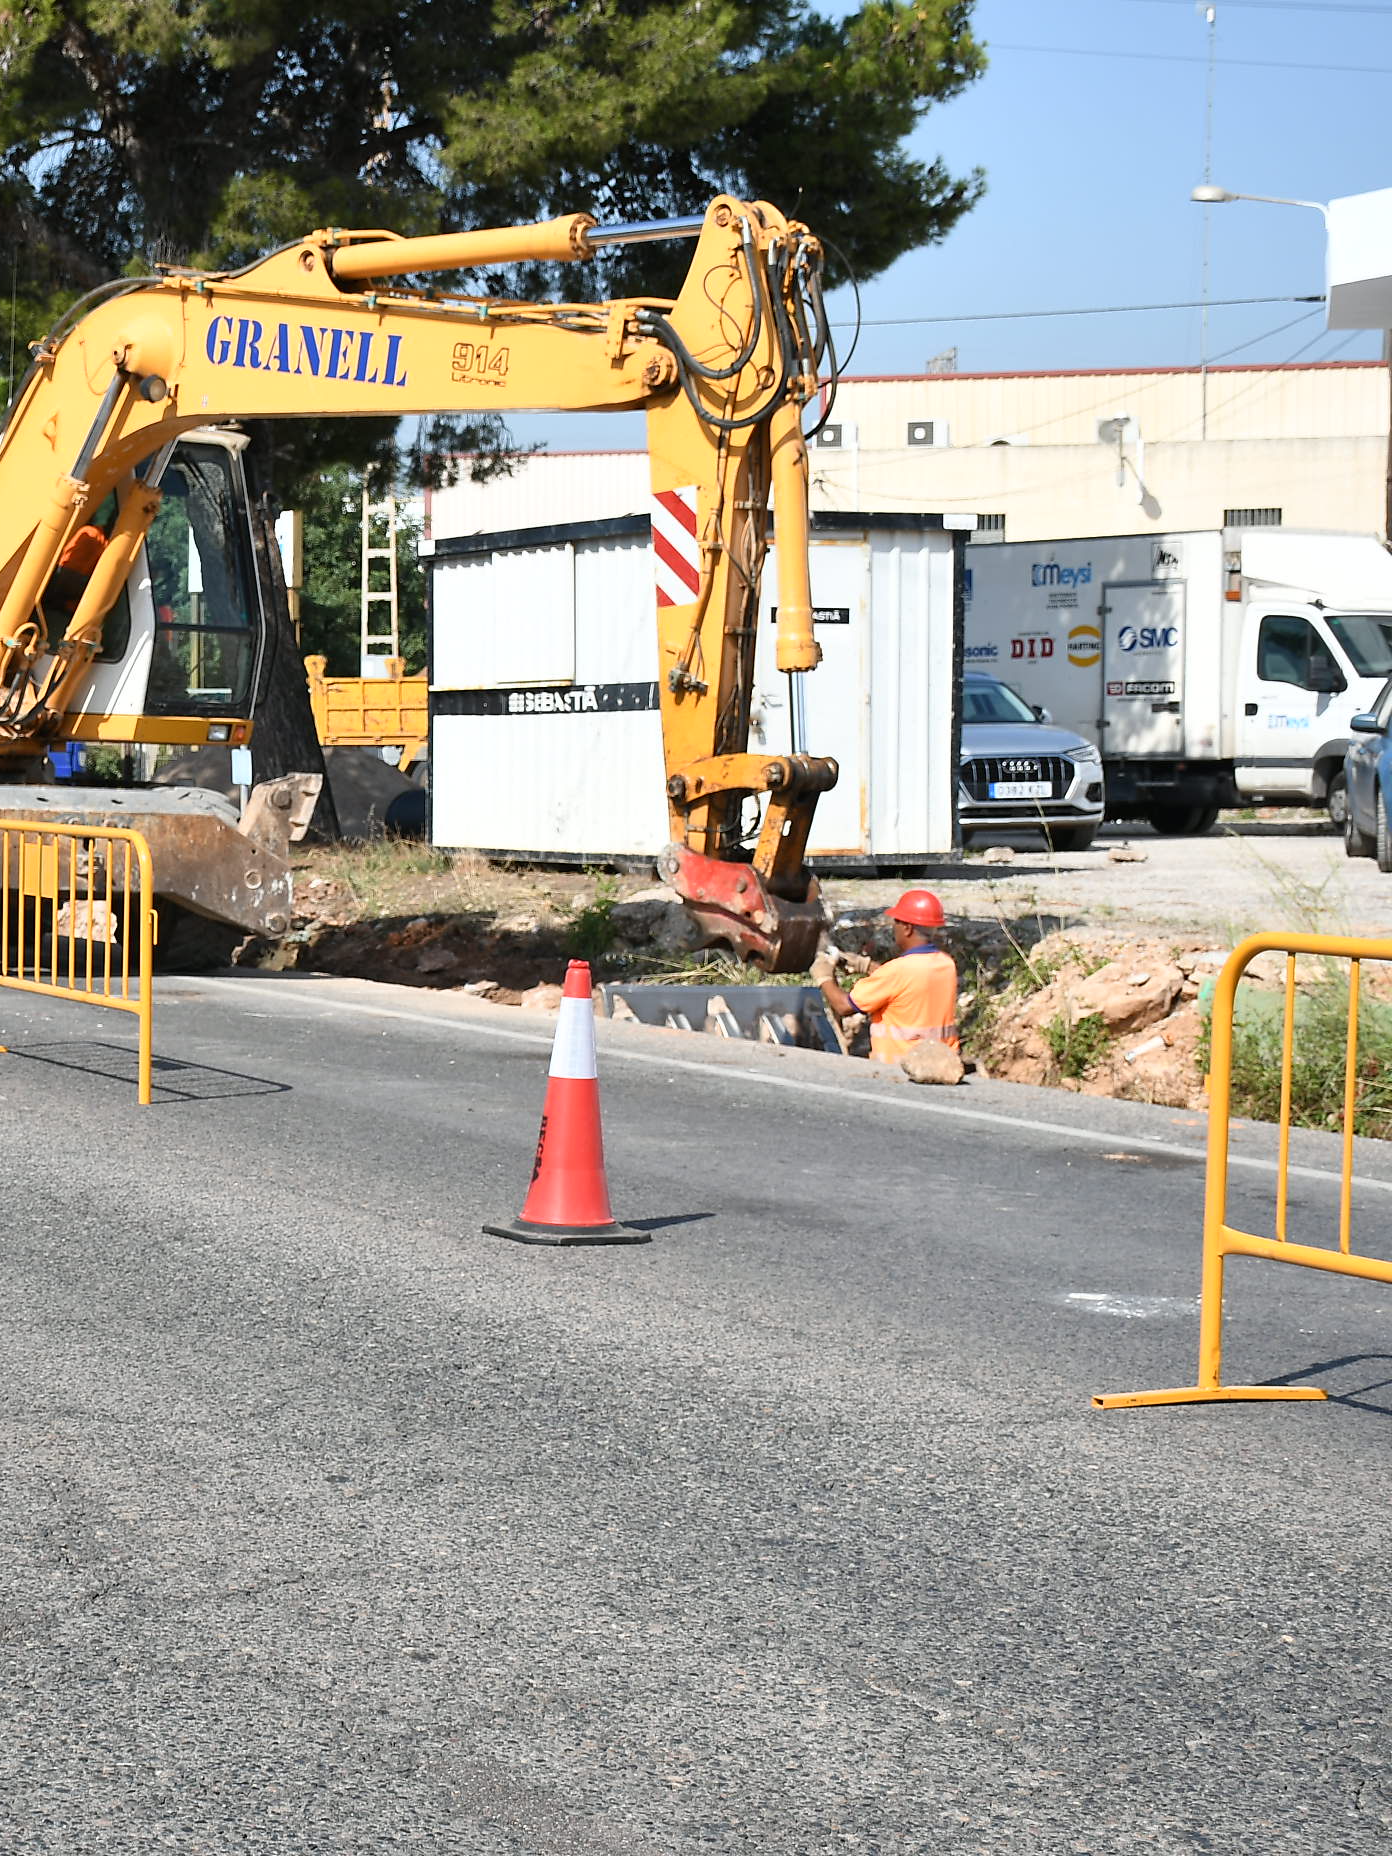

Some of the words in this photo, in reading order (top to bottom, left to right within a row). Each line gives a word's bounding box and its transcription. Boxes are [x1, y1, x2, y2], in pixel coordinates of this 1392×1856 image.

[206, 315, 408, 387] GRANELL
[452, 342, 509, 376] 914
[964, 643, 998, 658] sonic
[1139, 627, 1179, 648] SMC
